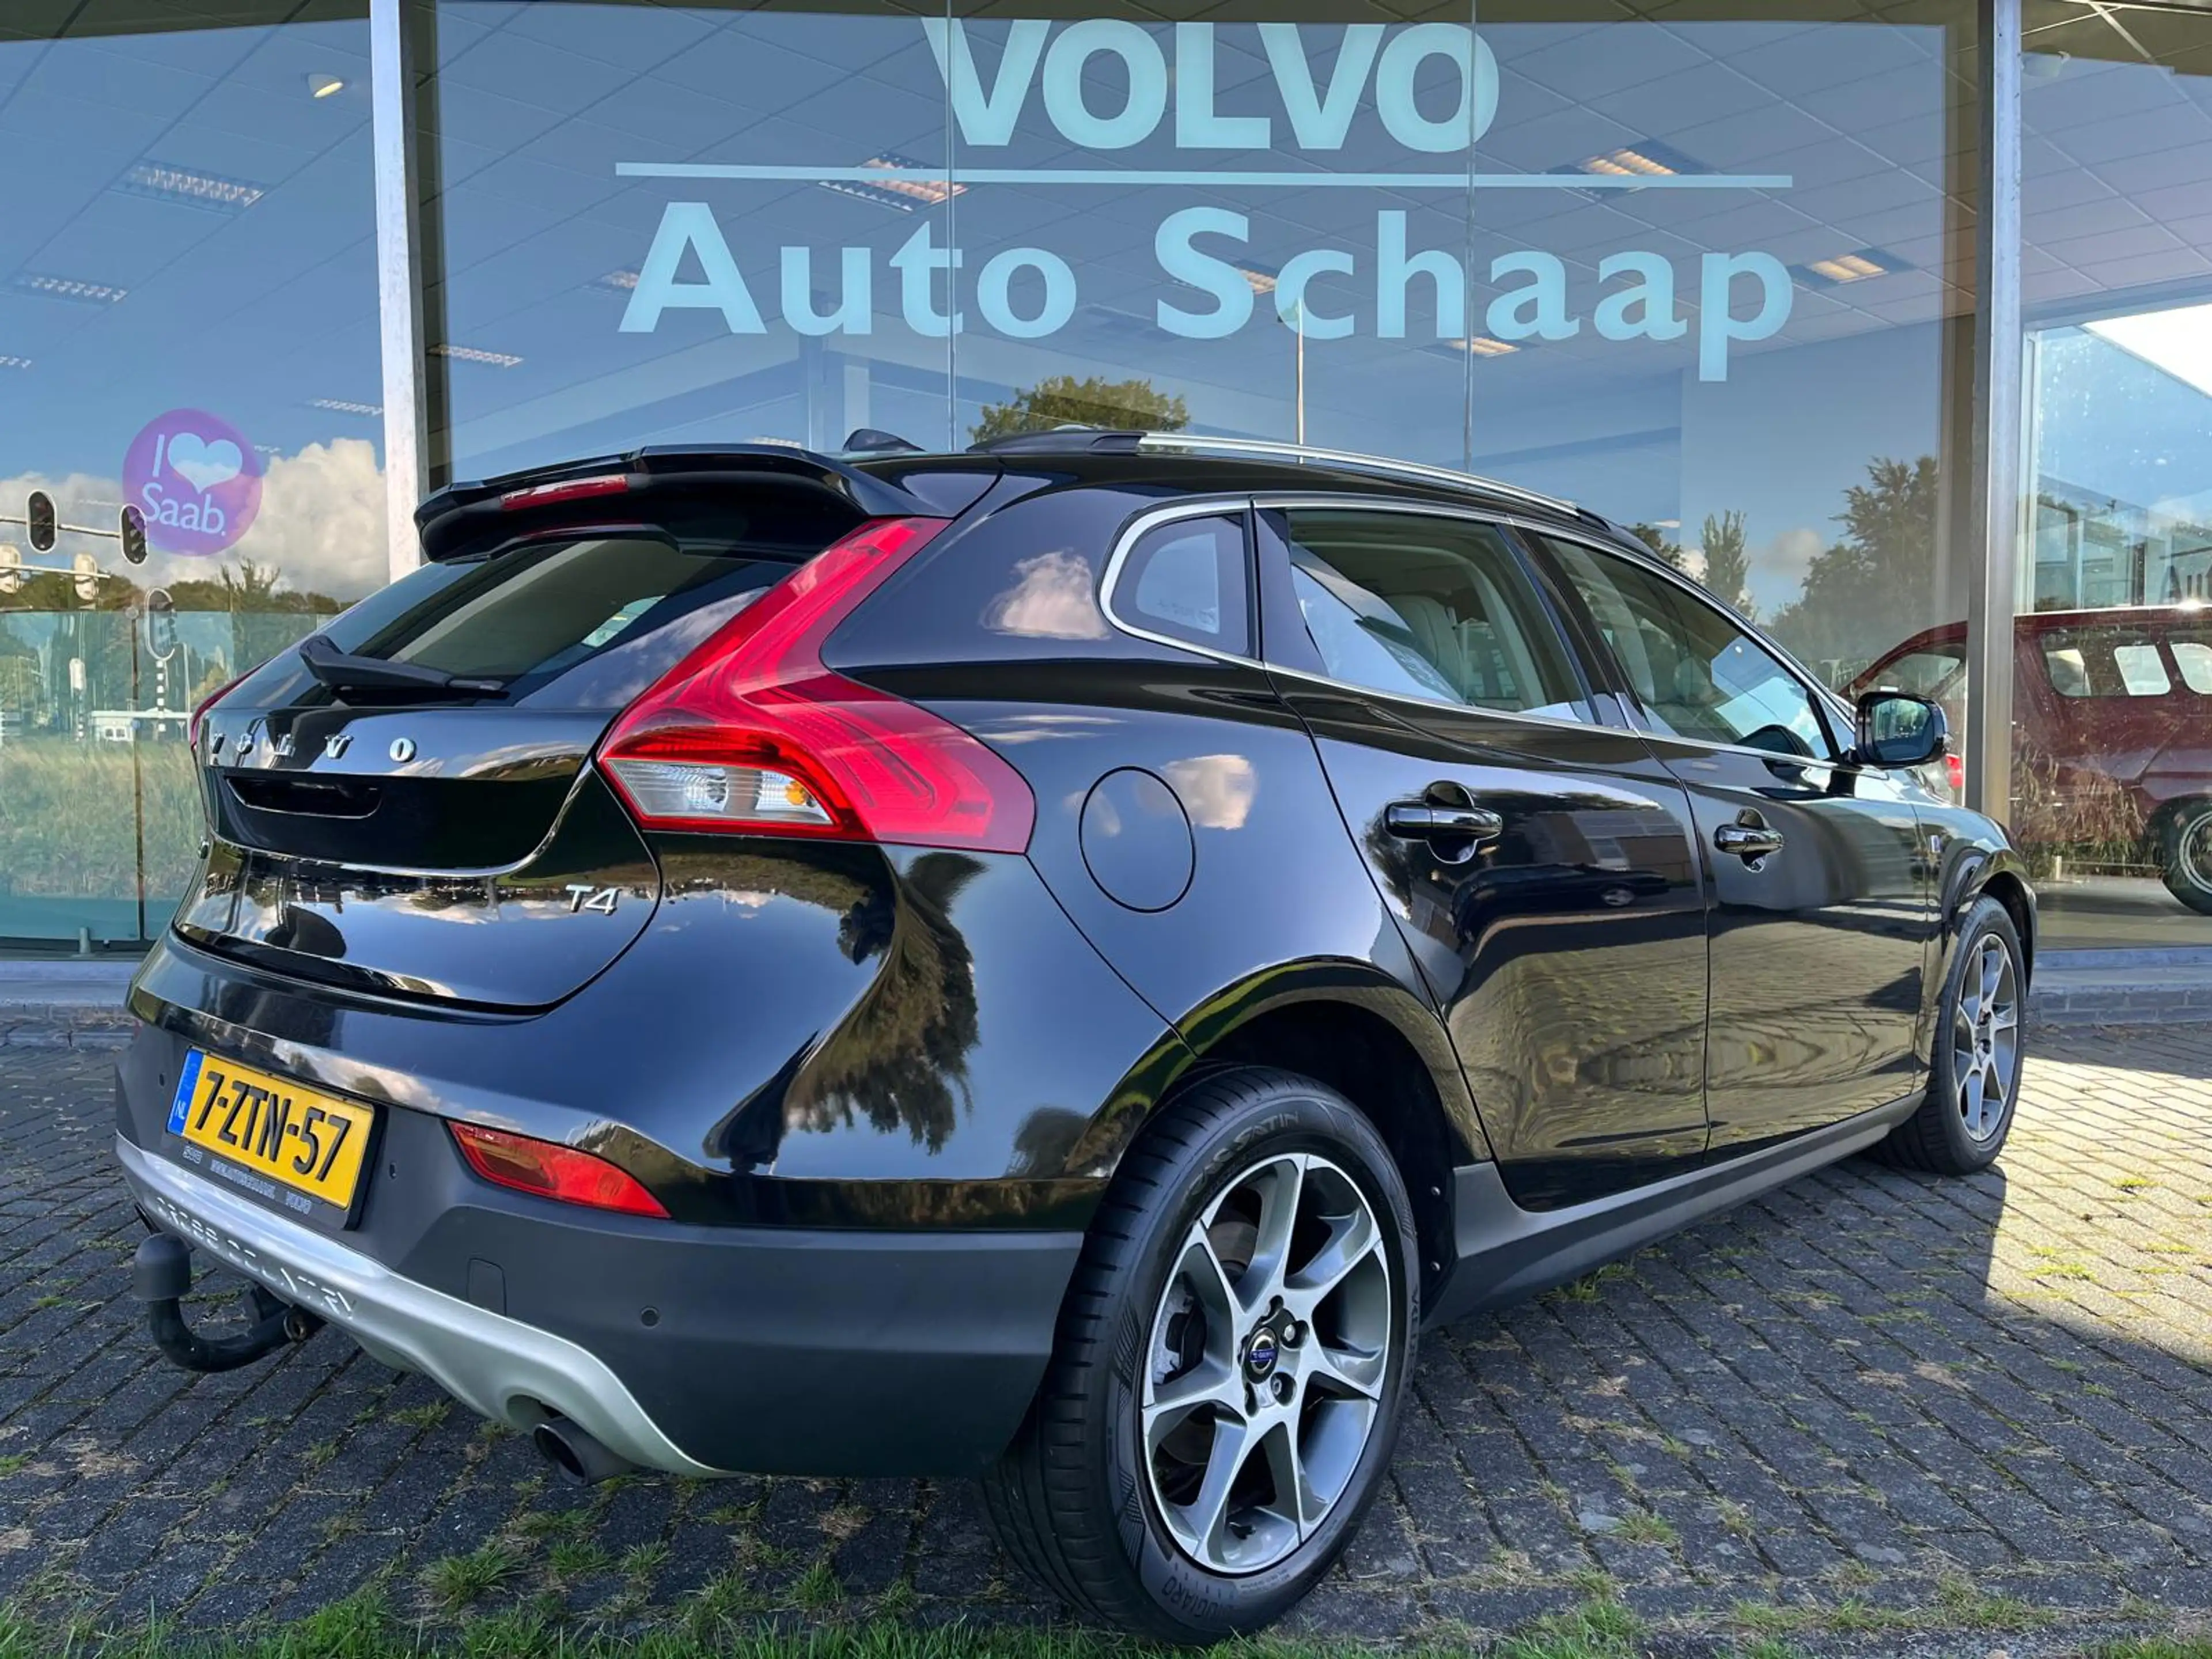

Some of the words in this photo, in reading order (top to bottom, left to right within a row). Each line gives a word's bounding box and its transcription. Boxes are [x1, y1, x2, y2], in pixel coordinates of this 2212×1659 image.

[921, 17, 1500, 153] VOLVO
[618, 202, 1079, 339] Auto
[1154, 206, 1794, 382] Schaap
[152, 434, 165, 478] I
[212, 732, 418, 763] VOLVO
[565, 884, 619, 916] T4
[175, 1099, 186, 1120] NL
[195, 1071, 352, 1182] 7-ZTN-57
